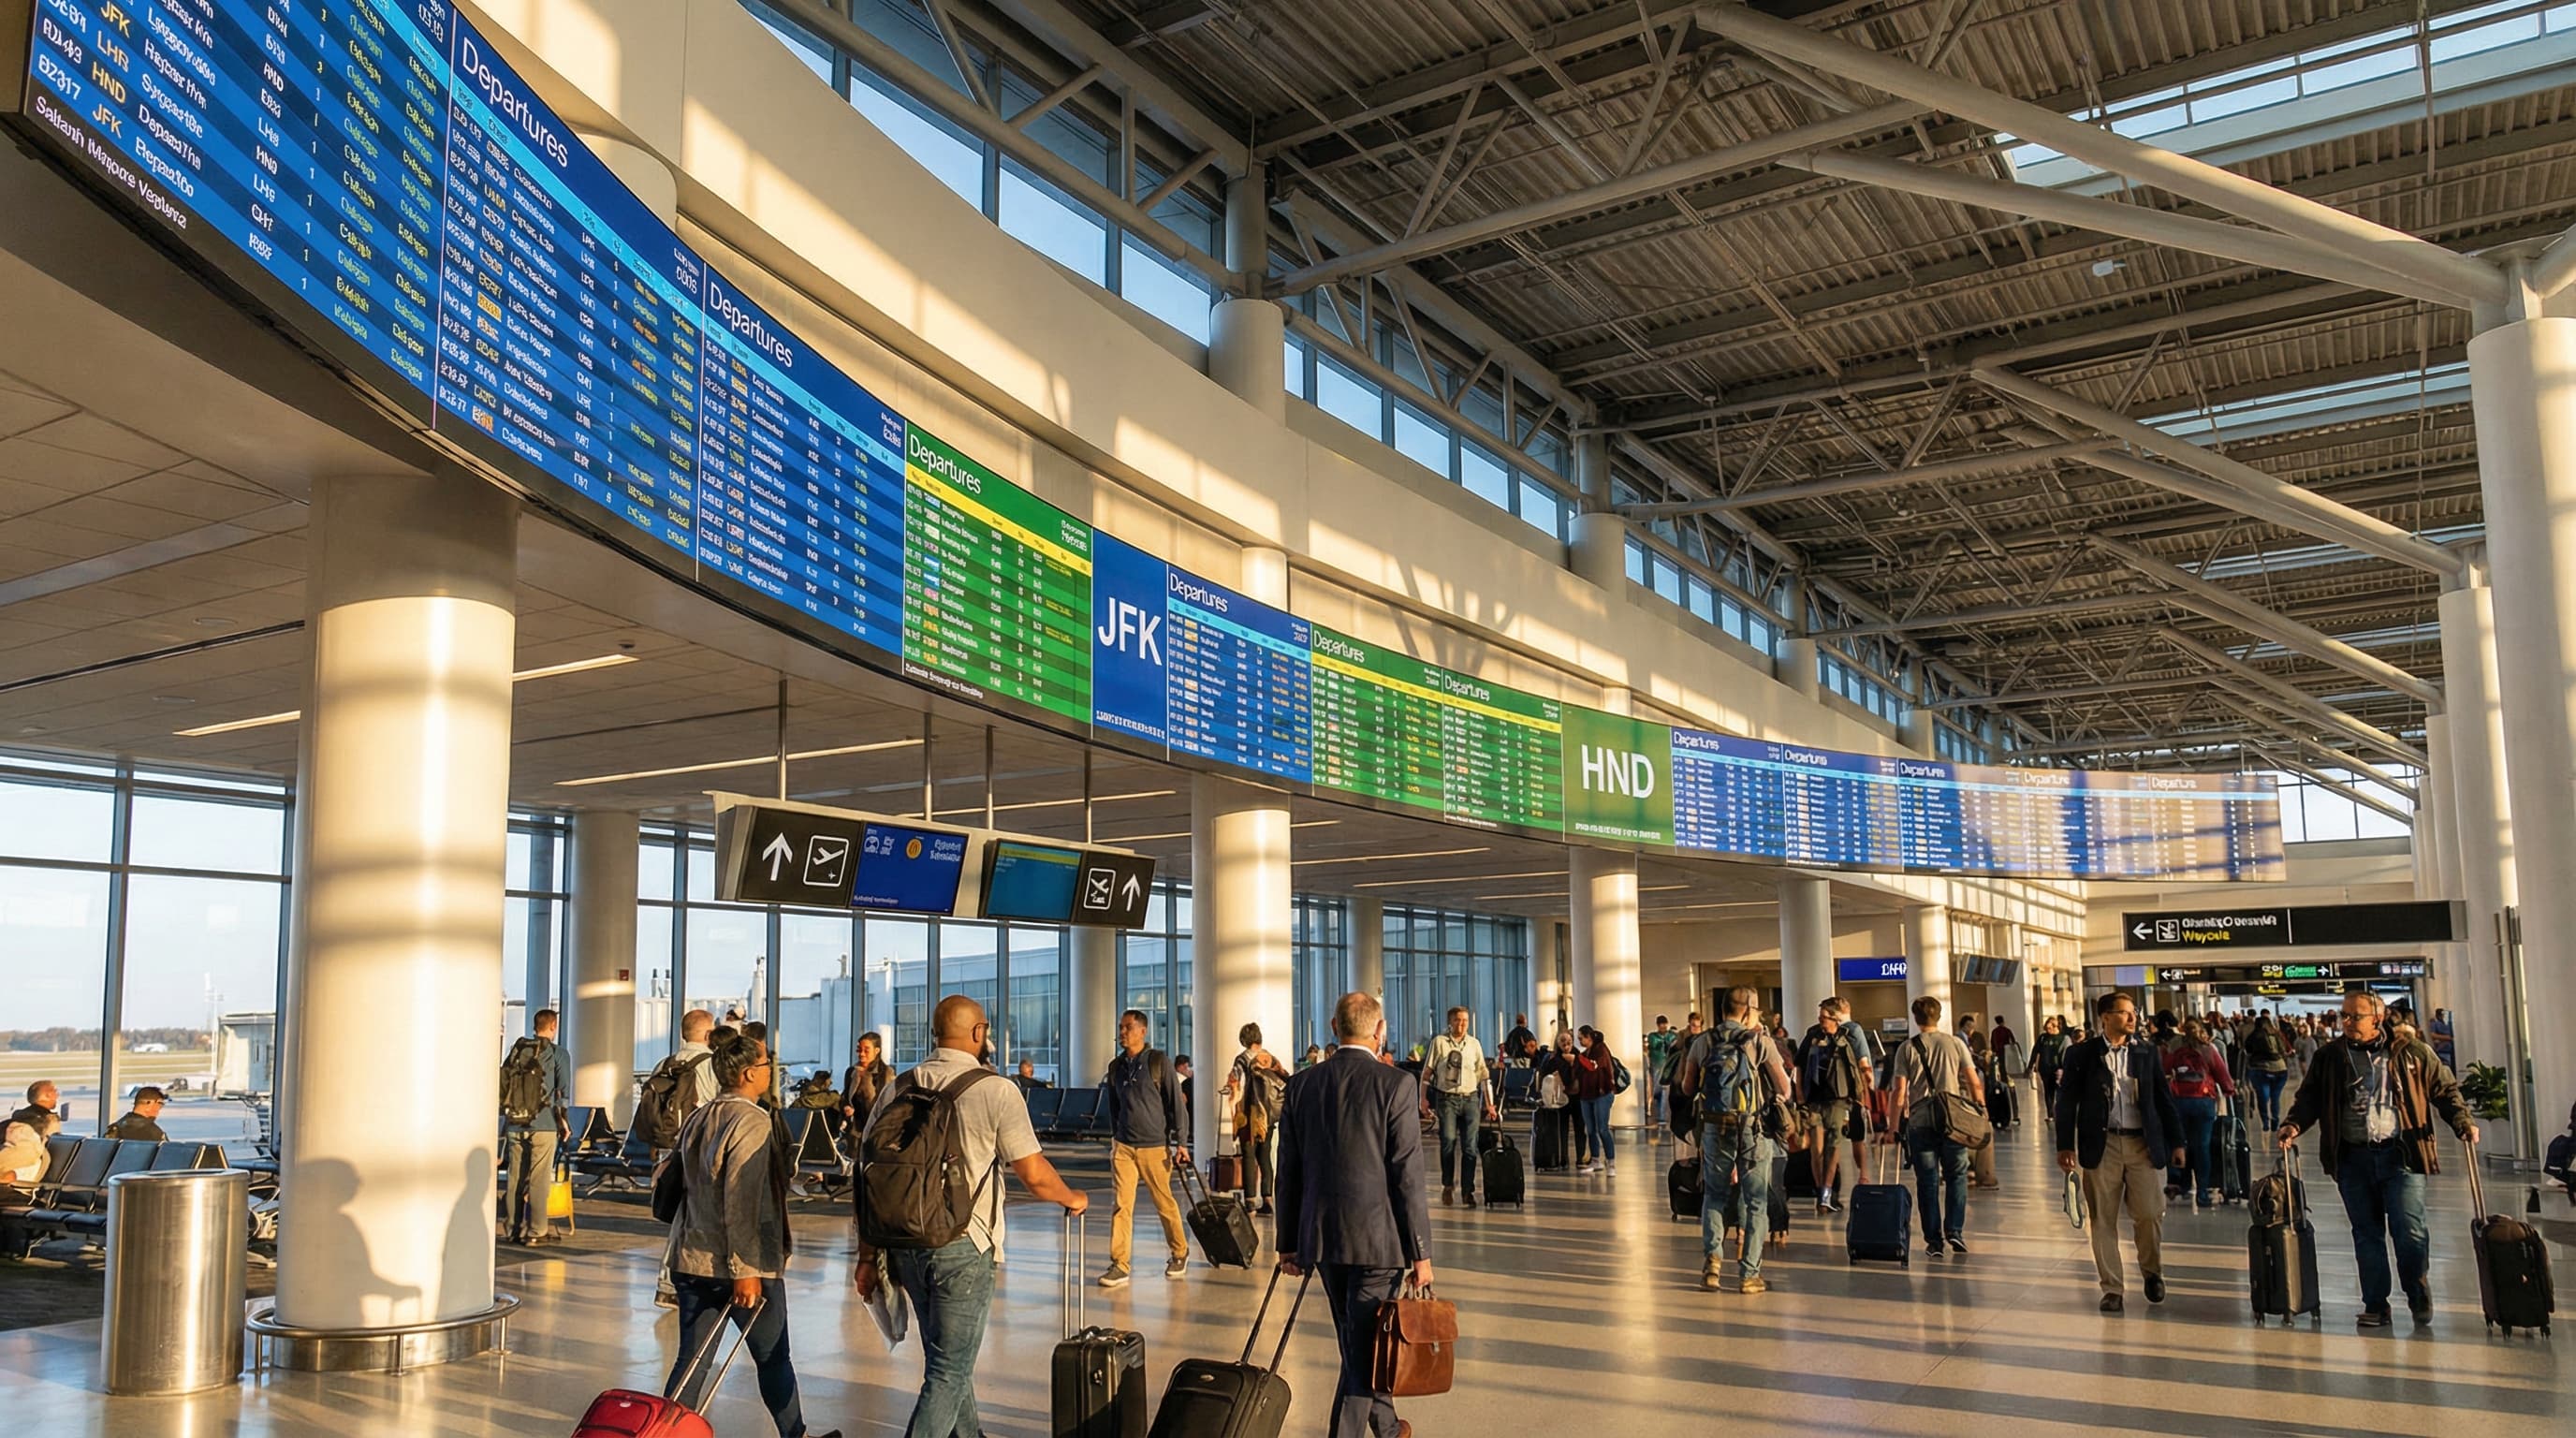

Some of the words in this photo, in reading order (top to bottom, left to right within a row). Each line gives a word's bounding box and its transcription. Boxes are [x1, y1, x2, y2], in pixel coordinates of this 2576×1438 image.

[100, 1, 130, 38] JFK
[92, 61, 126, 104] HND
[462, 37, 568, 169] Departures
[93, 104, 122, 139] JFK
[301, 277, 307, 290] 1
[710, 282, 793, 368] Departures
[910, 433, 982, 495] Departures
[1169, 572, 1228, 612] Departures
[1097, 596, 1163, 667] JFK
[1313, 630, 1365, 663] Departures
[1444, 675, 1490, 702] Departures
[1581, 744, 1655, 799] HND
